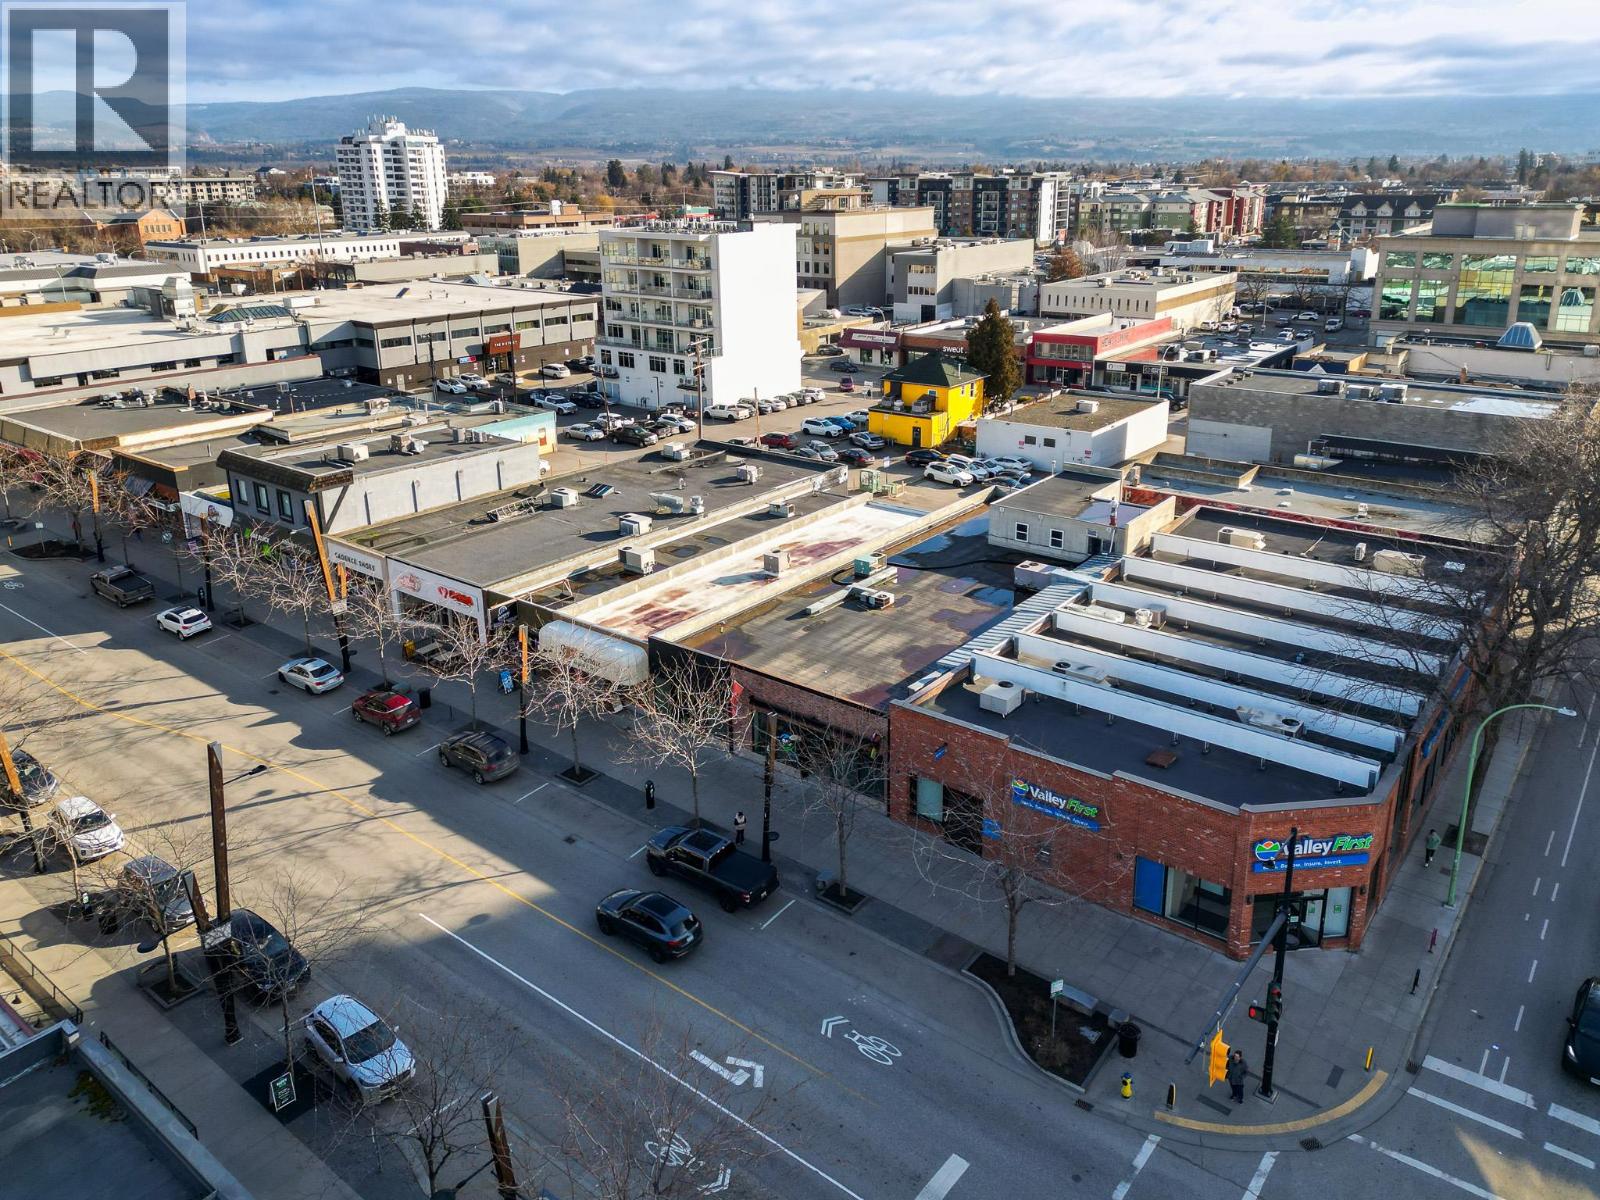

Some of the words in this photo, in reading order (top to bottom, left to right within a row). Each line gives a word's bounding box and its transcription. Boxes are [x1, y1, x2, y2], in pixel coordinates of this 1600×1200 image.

[334, 552, 358, 566] CADENCE
[358, 560, 375, 572] SHOES
[1029, 785, 1067, 809] Valley
[1066, 799, 1098, 818] First
[1332, 835, 1374, 852] First
